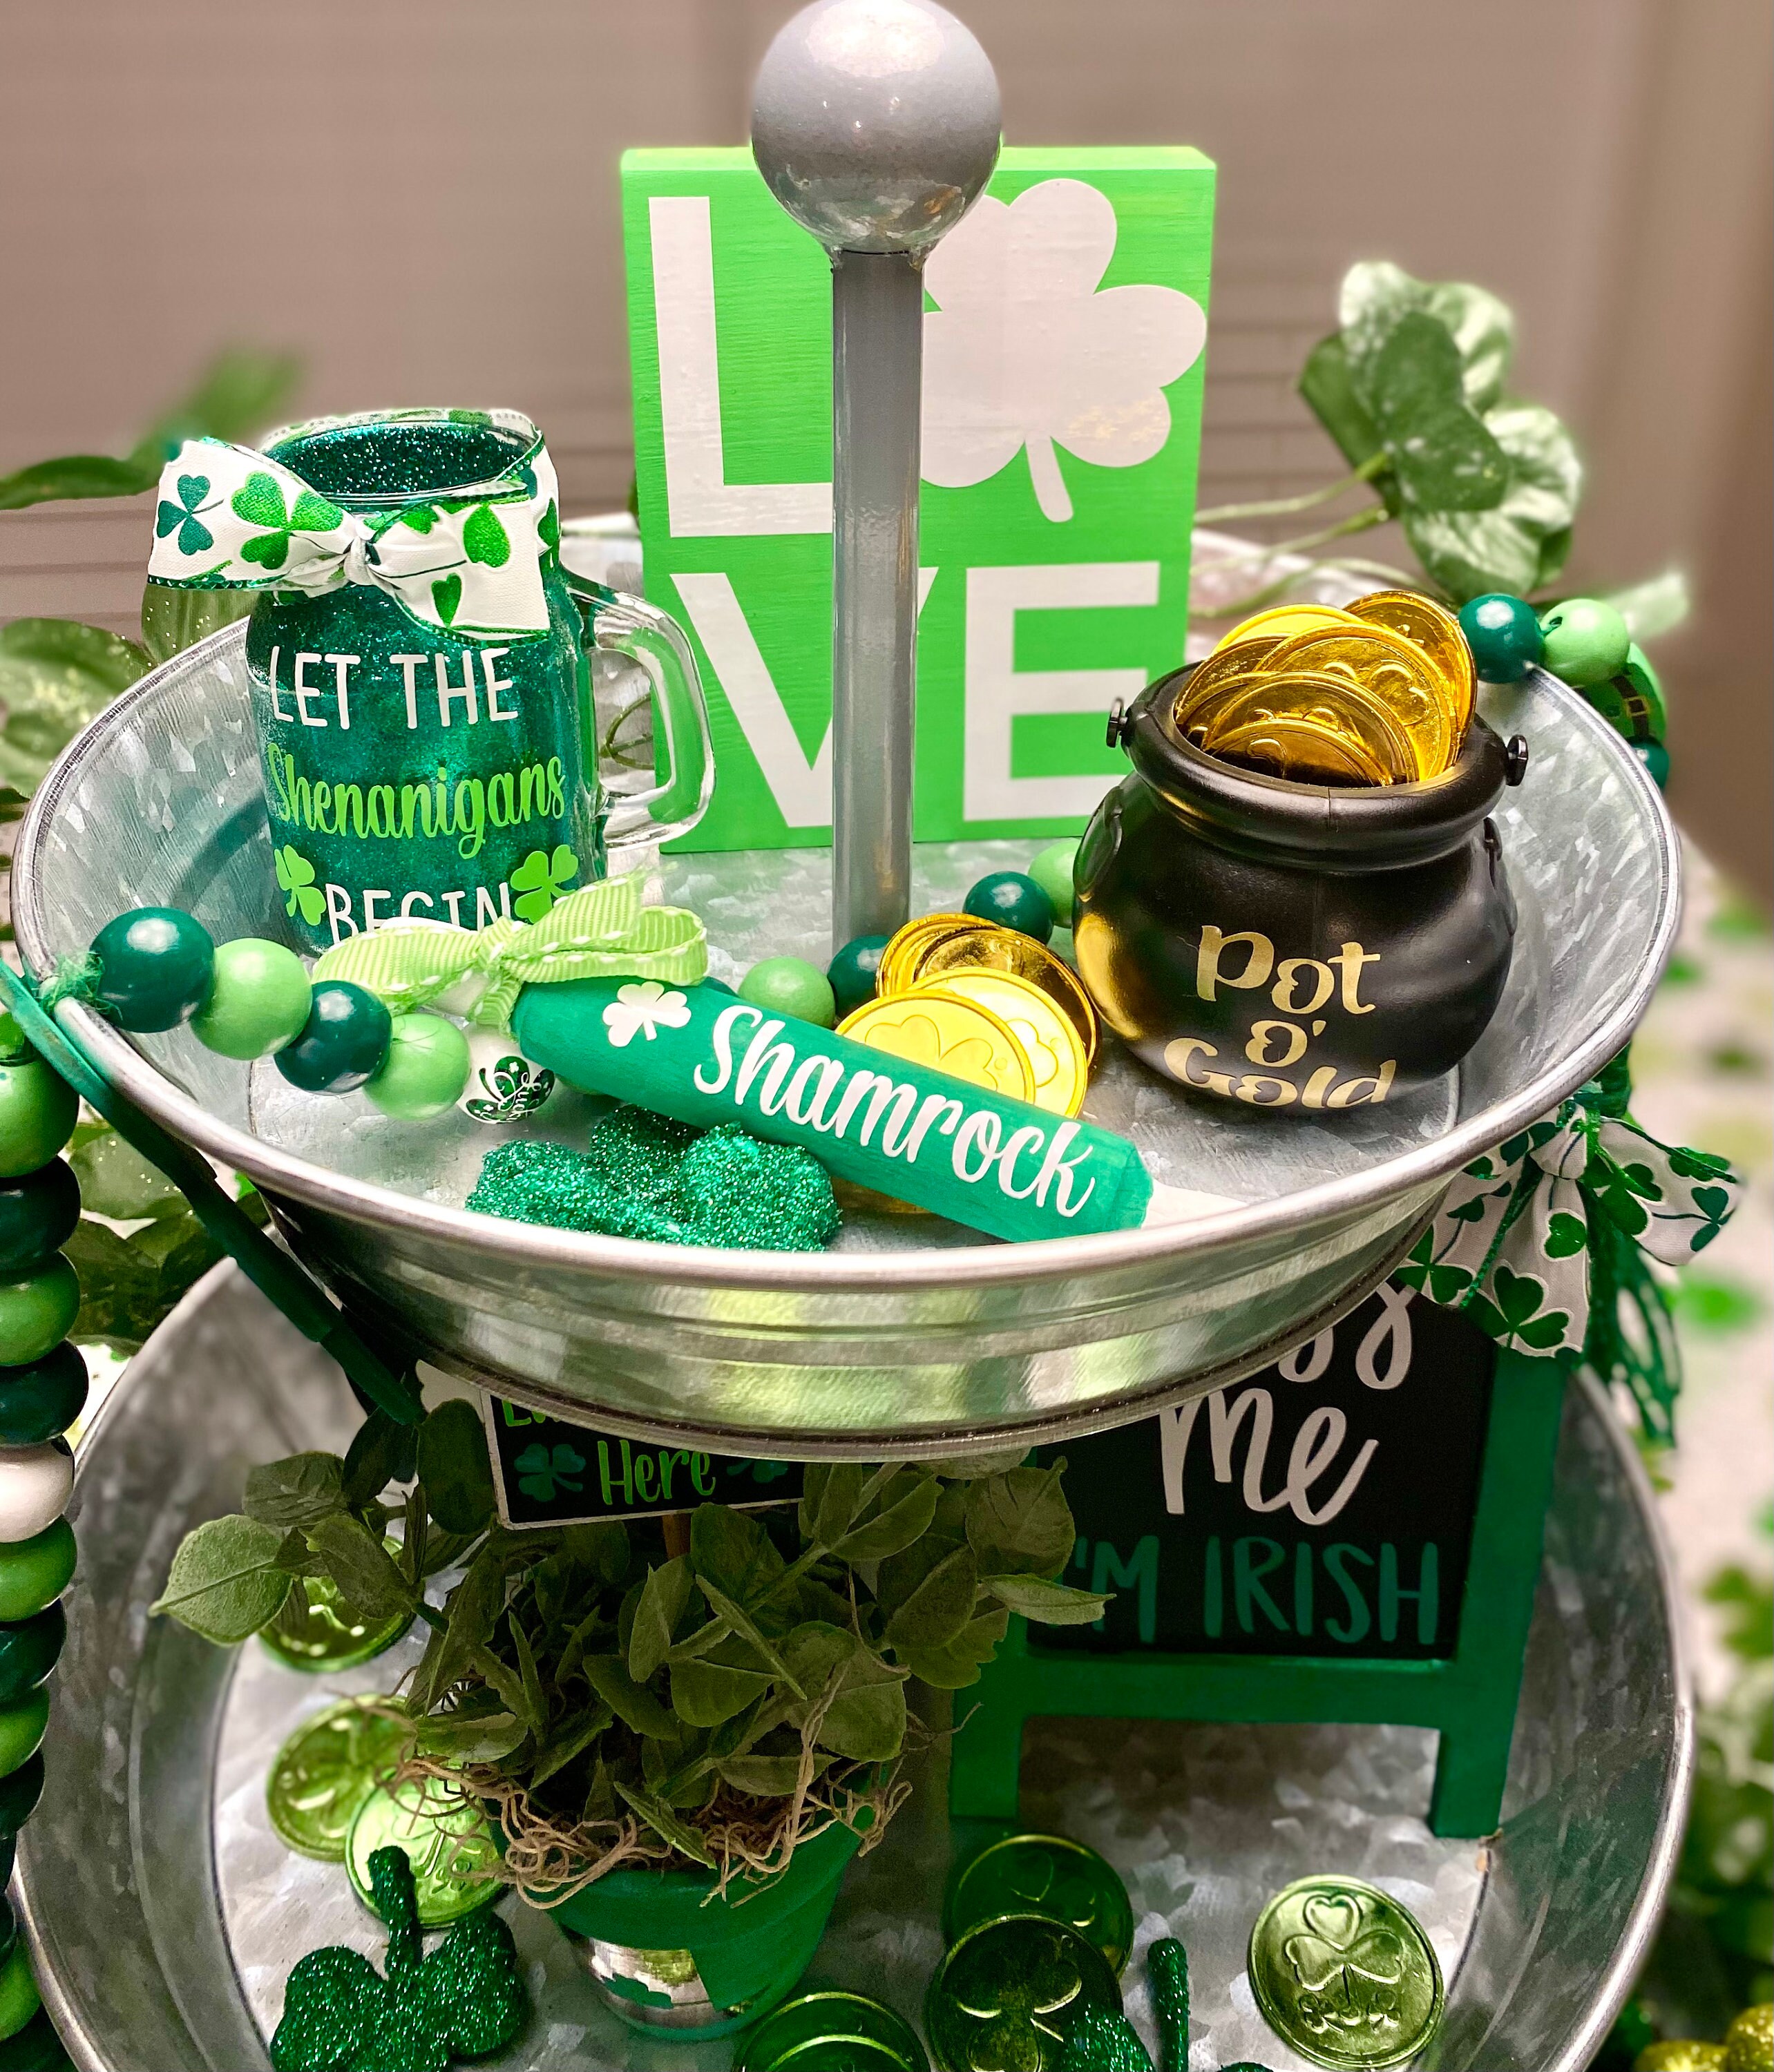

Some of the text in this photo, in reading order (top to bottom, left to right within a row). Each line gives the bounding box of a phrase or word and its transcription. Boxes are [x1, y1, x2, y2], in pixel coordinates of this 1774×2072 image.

[269, 646, 519, 730] LET THE
[267, 742, 566, 860] Shenanigans
[1196, 925, 1381, 1015] Pot
[693, 1005, 1096, 1218] Shamrock
[1163, 1037, 1397, 1109] Gold
[597, 1439, 716, 1506] Here
[1049, 1535, 1439, 1645] 'M IRISH
